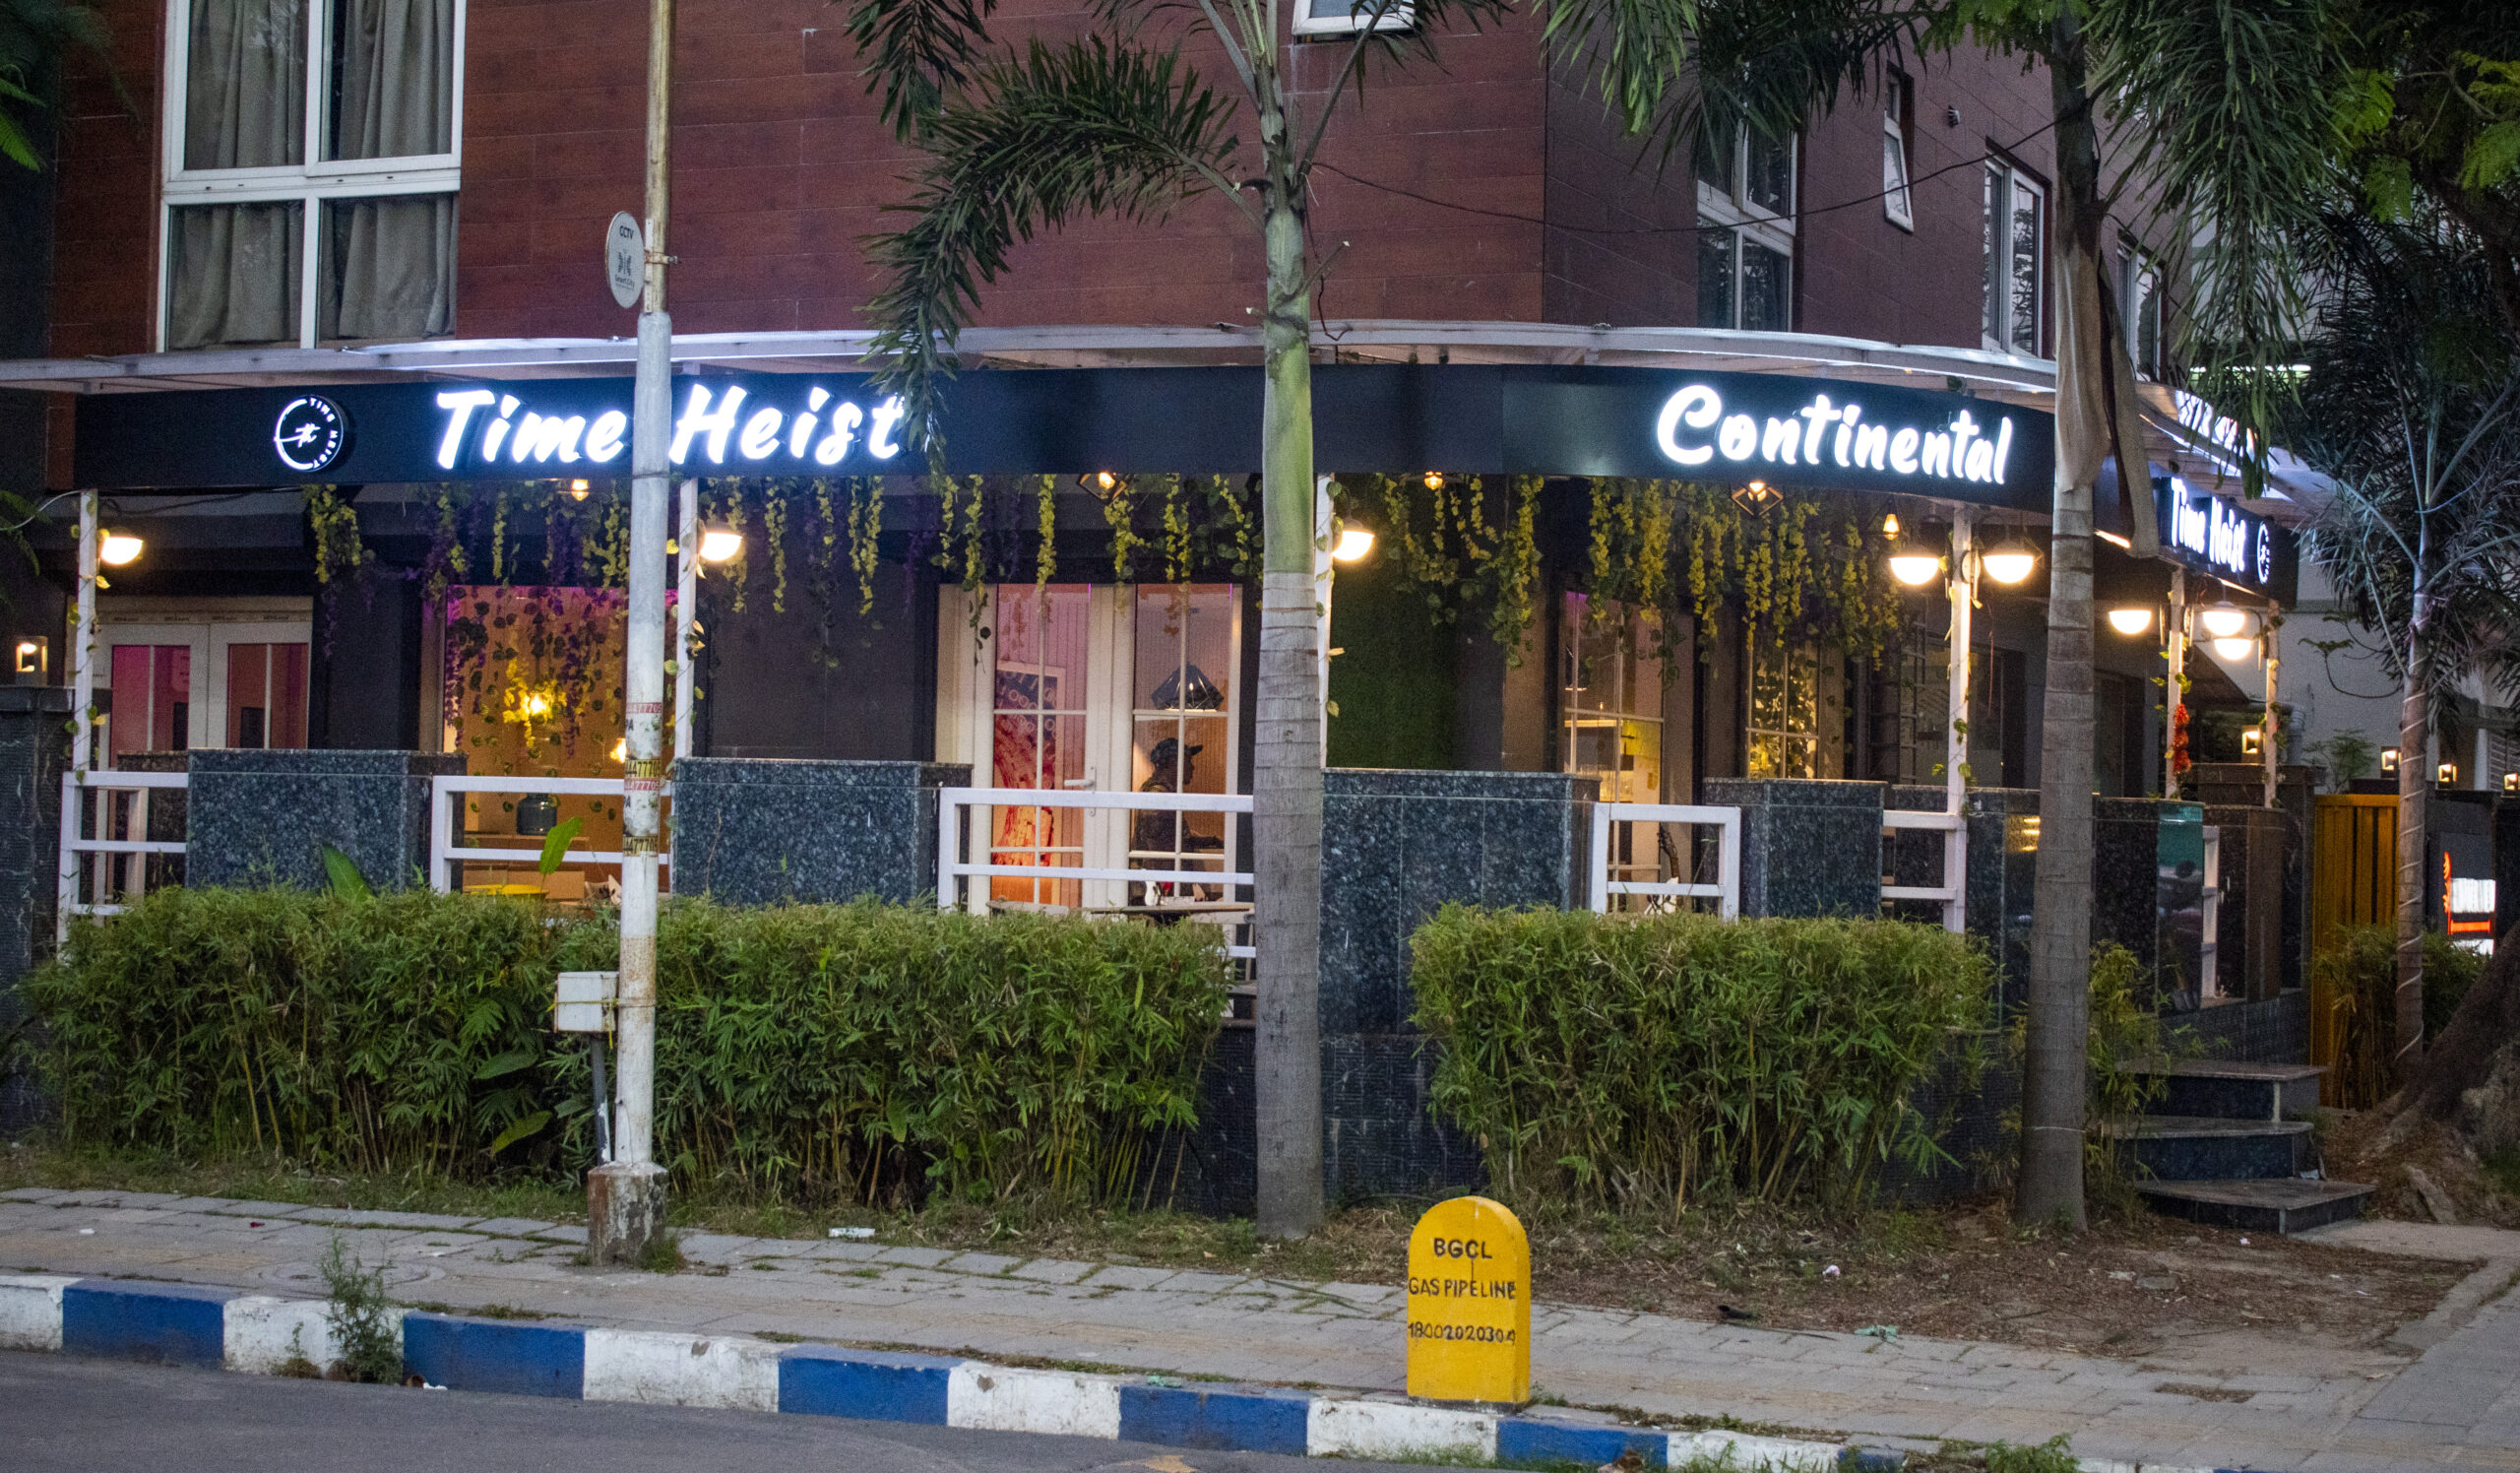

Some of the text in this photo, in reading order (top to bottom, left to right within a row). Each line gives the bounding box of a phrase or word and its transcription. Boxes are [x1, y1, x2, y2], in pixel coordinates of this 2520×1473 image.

[619, 225, 634, 239] CCTV
[310, 397, 336, 422] TIME
[435, 382, 907, 471] Time Heist
[1657, 384, 2014, 485] Continental
[2171, 476, 2207, 555] Time
[1433, 1237, 1493, 1259] BGCL
[1408, 1276, 1517, 1300] GAS PIPELINE
